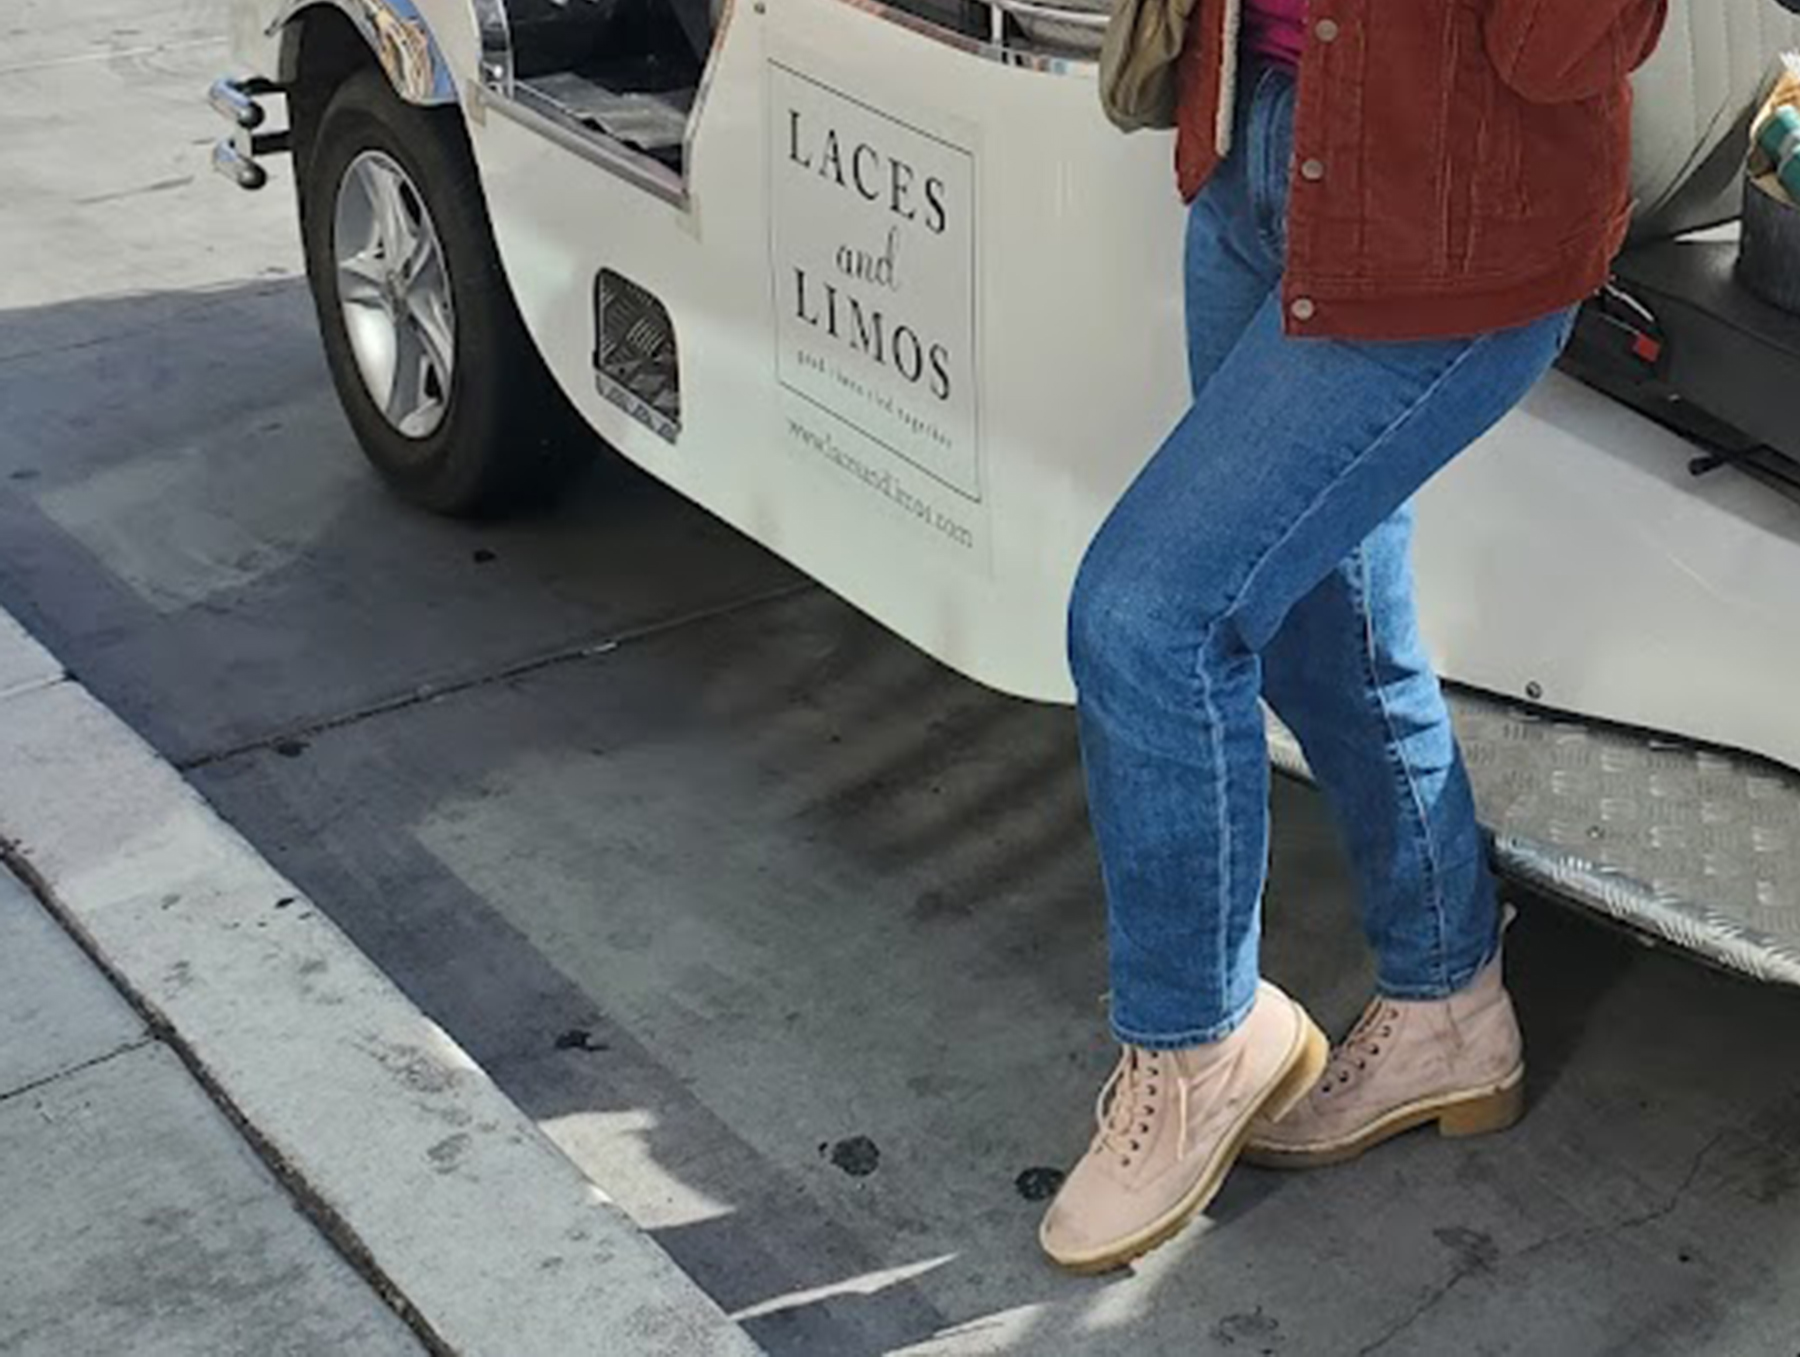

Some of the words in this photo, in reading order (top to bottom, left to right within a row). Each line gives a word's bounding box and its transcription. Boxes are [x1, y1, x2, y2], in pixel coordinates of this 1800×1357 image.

[788, 108, 946, 235] LACES
[835, 224, 901, 293] and
[793, 266, 950, 401] LIMOS
